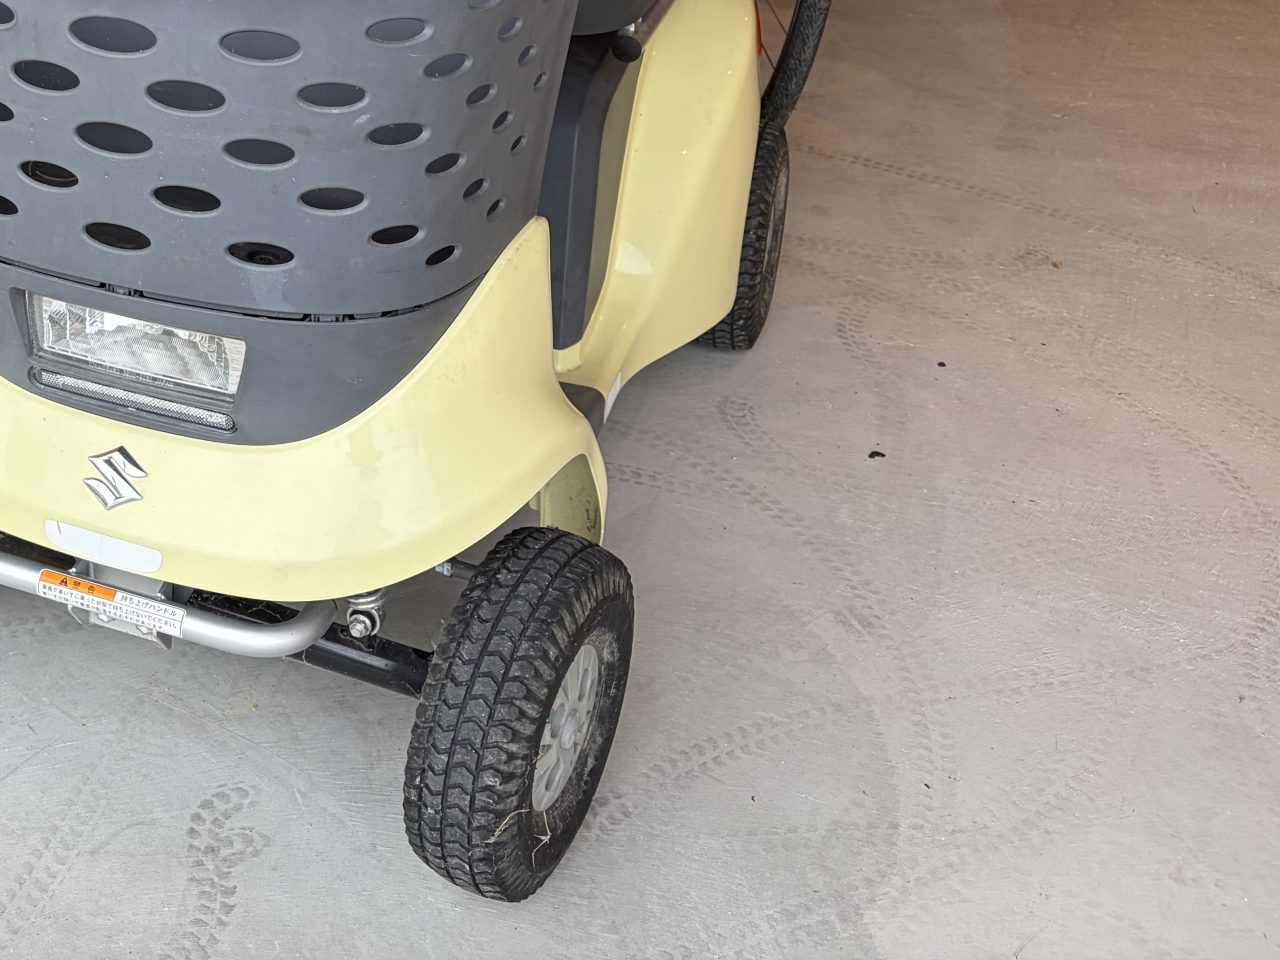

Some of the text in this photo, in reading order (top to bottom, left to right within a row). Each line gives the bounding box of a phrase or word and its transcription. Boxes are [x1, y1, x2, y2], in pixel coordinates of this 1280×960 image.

[120, 594, 178, 617] 持ち上げハンドル
